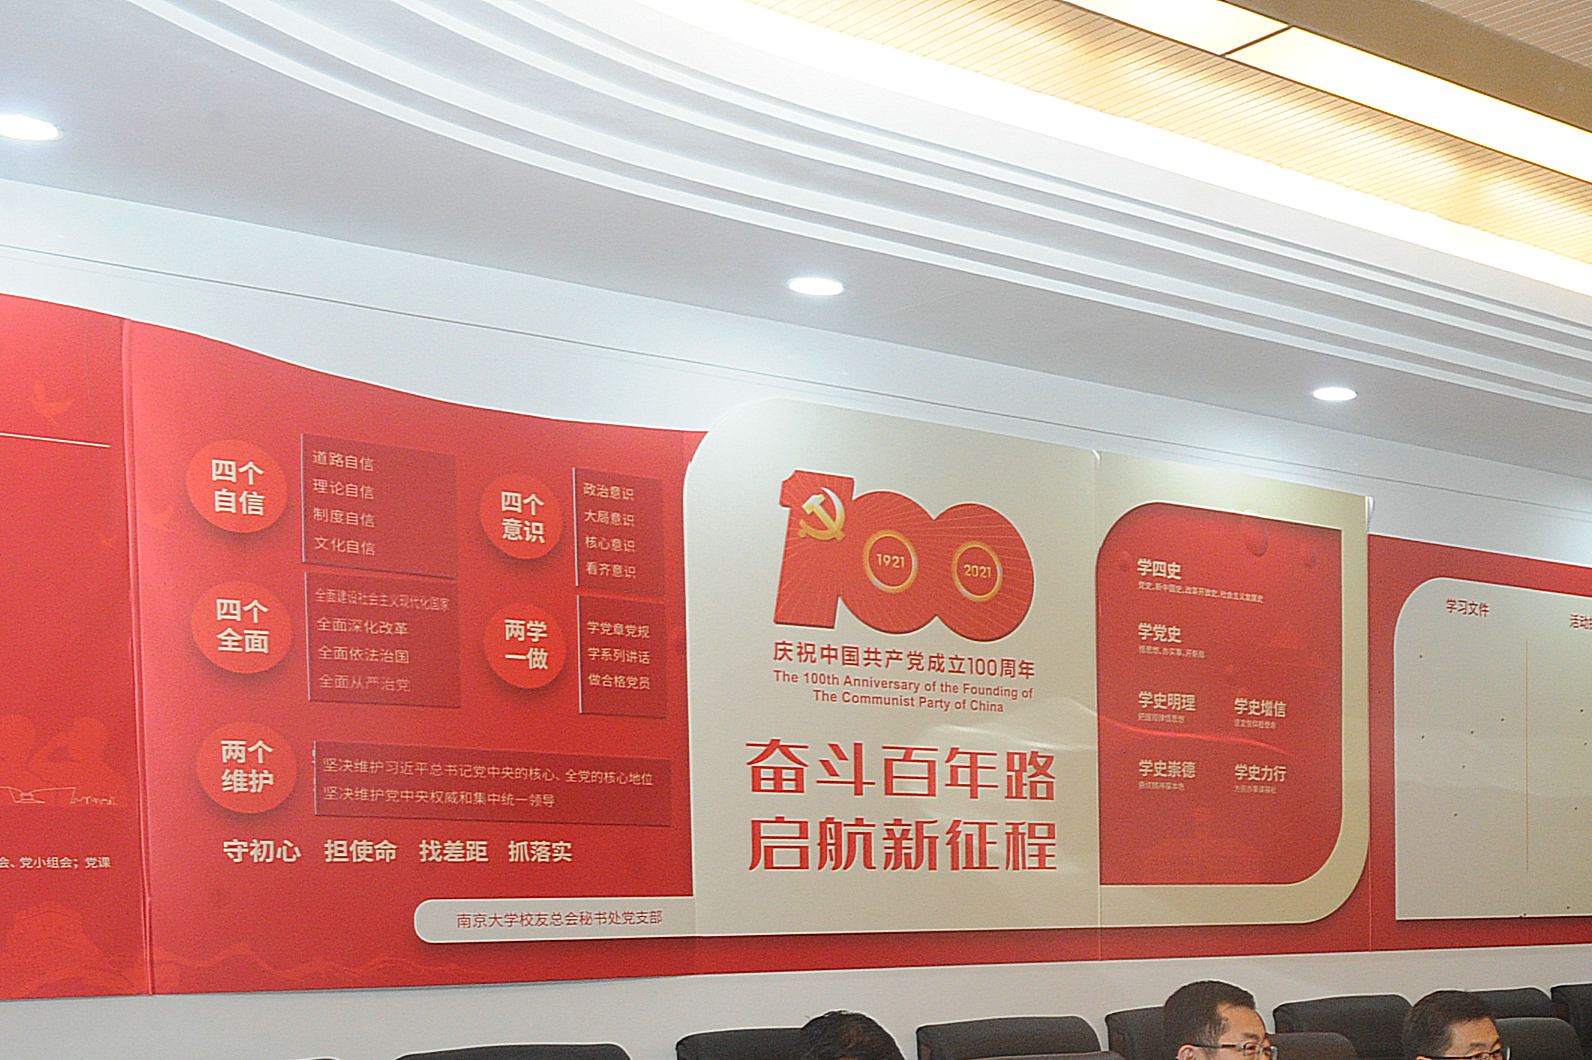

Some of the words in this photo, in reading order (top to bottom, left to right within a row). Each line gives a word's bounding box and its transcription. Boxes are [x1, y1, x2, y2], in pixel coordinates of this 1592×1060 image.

[312, 449, 374, 472] 道路自信
[211, 458, 264, 486] 四个
[312, 478, 374, 500] 理论自信
[583, 482, 634, 501] 政治意识
[213, 488, 265, 516] 自信
[500, 490, 544, 514] 四个
[313, 506, 375, 529] 制度自信
[584, 509, 635, 528] 大局意识
[501, 519, 545, 543] 意识
[314, 535, 376, 556] 文化自信
[584, 535, 636, 554] 核心意识
[585, 561, 637, 580] 看齐意识
[876, 553, 906, 569] 1921
[963, 564, 992, 580] 2021
[1137, 558, 1182, 580] 学四史
[215, 597, 268, 624] 四个
[315, 588, 450, 611] 全面建设社会主义现代化国家
[1446, 599, 1490, 617] 学习文件
[317, 616, 408, 635] 全面深化改革
[504, 618, 549, 642] 两学
[586, 620, 651, 640] 学党章党规
[1138, 623, 1182, 643] 学党史
[216, 627, 270, 654] 全面
[318, 645, 409, 664] 全面依法治国
[505, 646, 549, 671] 一做
[587, 647, 651, 666] 学系列讲话
[773, 641, 1036, 679] 庆祝中国共产党成立100周年
[318, 673, 411, 692] 全面从严治党
[588, 672, 652, 691] 做合格党员
[773, 670, 799, 683] The
[804, 672, 840, 687] 100th
[843, 674, 921, 693] Anniversary
[924, 680, 938, 693] of
[941, 681, 960, 694] the
[963, 683, 1019, 700] Founding
[1021, 688, 1034, 700] of
[813, 689, 838, 703] The
[841, 691, 916, 707] Communist
[919, 696, 951, 712] Party
[954, 699, 967, 711] of
[970, 700, 1004, 713] China
[1138, 690, 1196, 711] 学史明理
[1234, 698, 1287, 718] 学史增信
[220, 738, 274, 764] 两个
[745, 738, 1057, 801] 奋斗百年路
[1139, 759, 1196, 778] 学史崇德
[1235, 763, 1287, 782] 学史力行
[221, 768, 274, 794] 维护
[323, 786, 556, 808] 坚决维护党中央权威和集中统一领导
[223, 838, 301, 863] 守初心
[324, 838, 397, 863] 担使命
[419, 839, 489, 863] 找差距
[508, 839, 572, 863] 抓落实
[748, 815, 1058, 871] 启航新征程
[456, 909, 664, 929] 南京大学校友总会秘书处党支部
